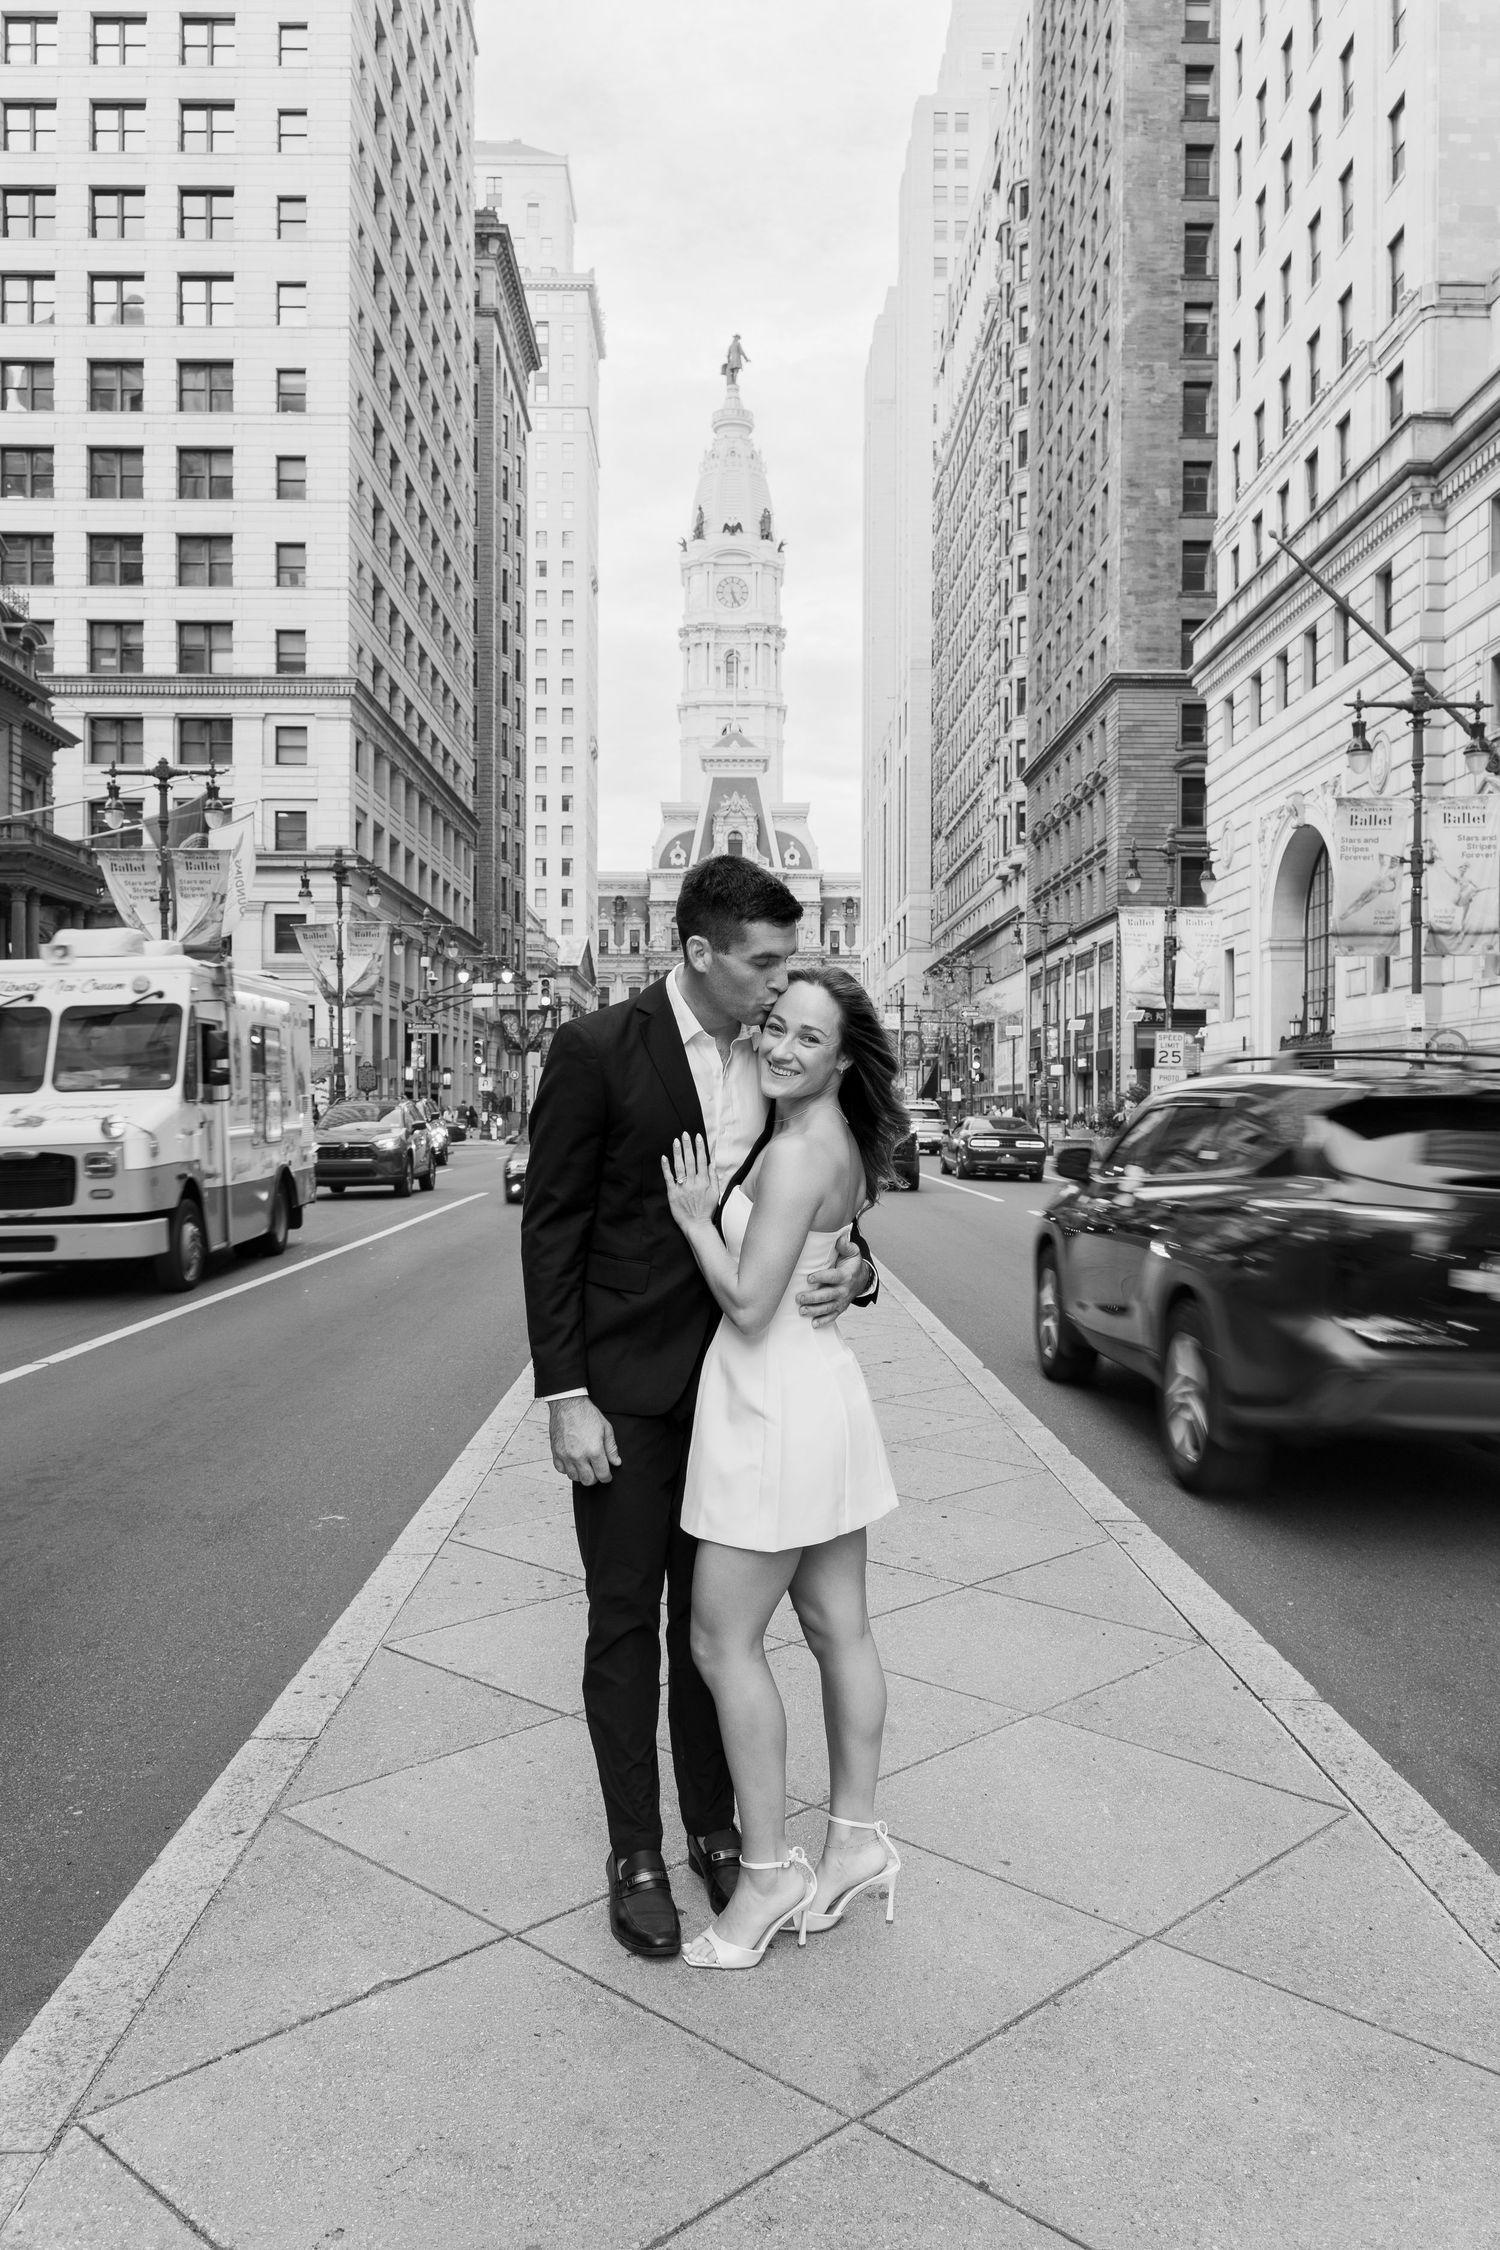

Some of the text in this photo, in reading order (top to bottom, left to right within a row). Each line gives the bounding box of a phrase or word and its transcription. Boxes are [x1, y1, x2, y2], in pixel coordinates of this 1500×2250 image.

[1350, 814, 1393, 826] Ballet
[1443, 812, 1486, 824] Ballet
[1341, 836, 1379, 844] Stars and
[1340, 845, 1369, 853] Stripes
[1467, 843, 1497, 851] Stripes
[110, 862, 146, 872] Ballet
[185, 861, 220, 871] Ballet
[1158, 1050, 1182, 1063] 25
